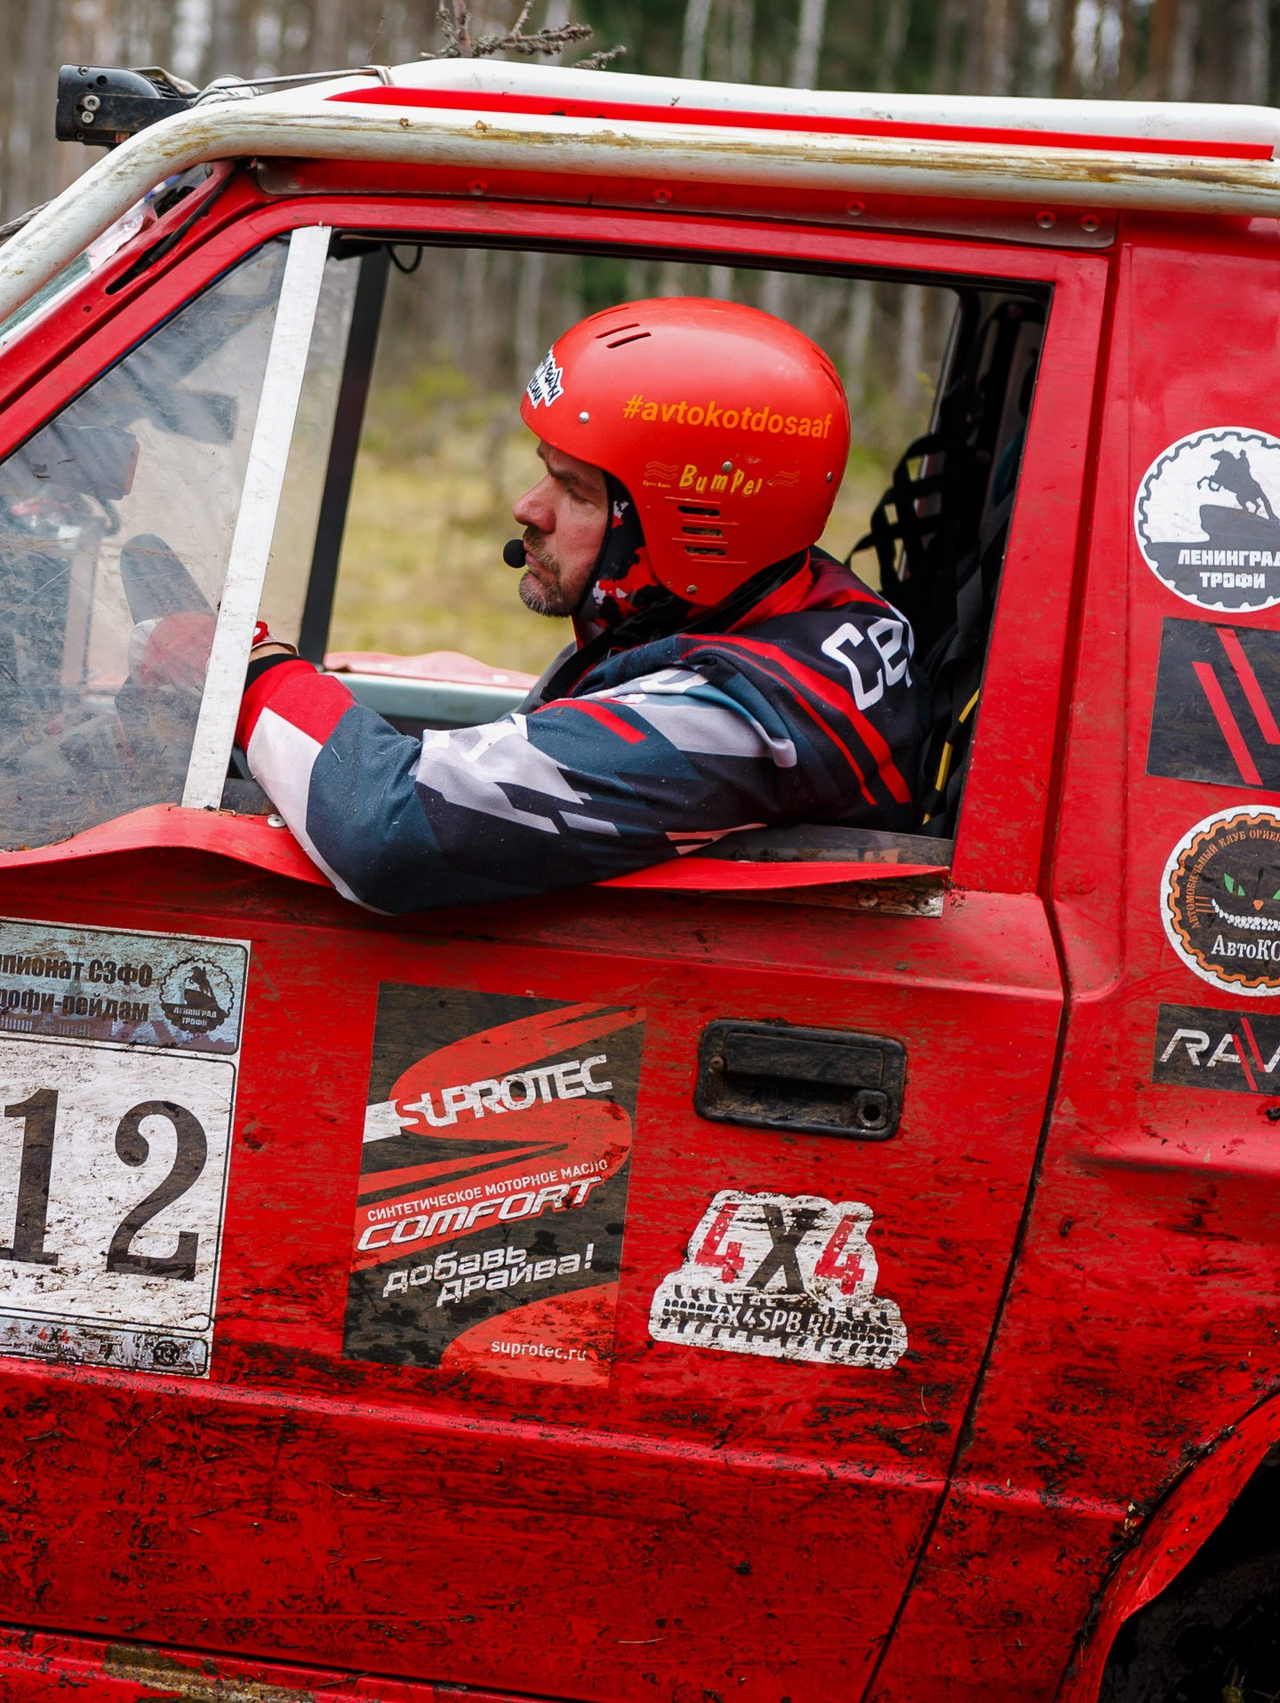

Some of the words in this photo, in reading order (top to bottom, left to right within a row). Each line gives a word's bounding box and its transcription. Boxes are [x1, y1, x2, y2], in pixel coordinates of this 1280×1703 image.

[622, 394, 832, 440] #avtokotdosaaf
[1199, 571, 1266, 589] ТРОФИ
[1218, 830, 1247, 848] КЛУБ
[88, 960, 153, 988] СЗФО
[384, 1054, 613, 1130] SUPROTEC
[357, 1175, 602, 1252] COMFORT
[367, 1186, 483, 1222] СИНТЕТИЧЕСКОЕ
[485, 1169, 558, 1196] МОТОРНОЕ
[560, 1158, 609, 1179] МАСЛО
[382, 1245, 528, 1298] добавь
[436, 1243, 595, 1307] драйва!
[694, 1202, 865, 1296] 4X4
[491, 1339, 588, 1362] suprotec.ru
